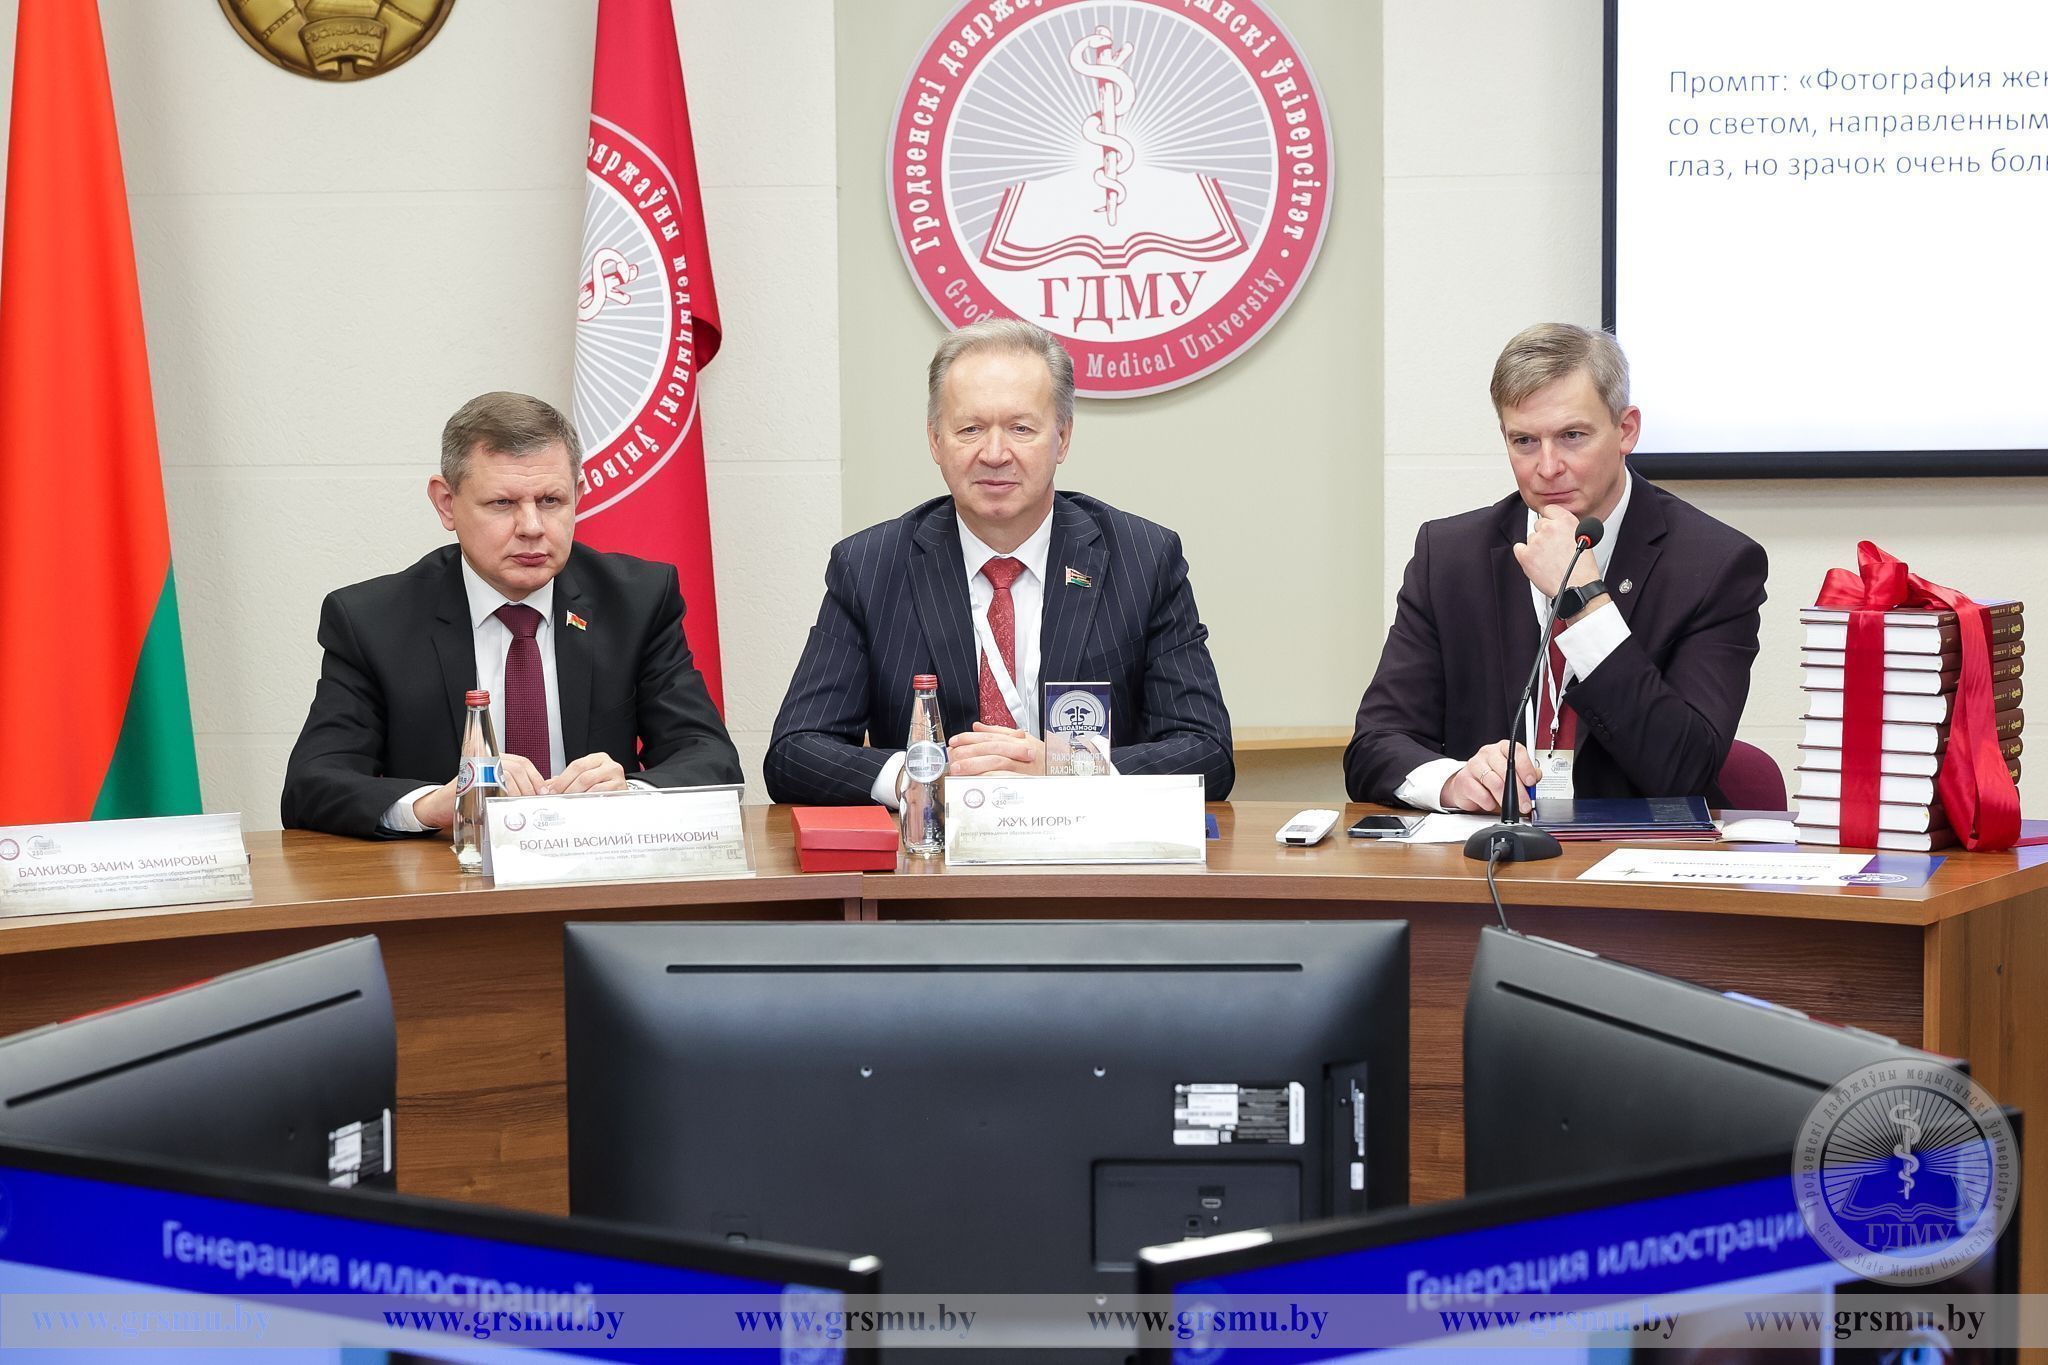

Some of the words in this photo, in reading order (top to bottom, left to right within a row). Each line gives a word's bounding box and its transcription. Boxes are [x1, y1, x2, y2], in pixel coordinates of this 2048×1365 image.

[1670, 70, 1788, 98] Промпт:
[1799, 65, 1991, 95] «Фотография
[1668, 116, 1699, 136] со
[1709, 115, 1818, 137] светом,
[1828, 113, 2048, 138] направленным
[905, 77, 946, 255] Гродзенскі
[1261, 58, 1321, 240] ўніверсітэт
[1668, 158, 1735, 180] глаз,
[1744, 156, 1778, 176] но
[1788, 155, 1887, 180] зрачок
[1896, 154, 1981, 174] очень
[944, 277, 994, 324] Grod
[1086, 344, 1176, 379] Medical
[1179, 267, 1285, 360] University
[1038, 270, 1207, 334] ГДМУ
[653, 253, 694, 428] медыцынскі
[519, 838, 569, 851] БОГДАН
[574, 832, 633, 847] ВАСИЛИЙ
[638, 830, 719, 844] ГЕНРИХОВИЧ
[997, 817, 1027, 827] ЖУК
[1032, 816, 1071, 827] ИГОРЬ
[18, 863, 87, 878] БАЛКИЗОВ
[90, 861, 134, 873] ЗАЛИМ
[138, 854, 218, 870] ЗАМИРОВИЧ
[162, 1219, 340, 1286] Генерация
[1406, 1249, 1589, 1313] Генерация
